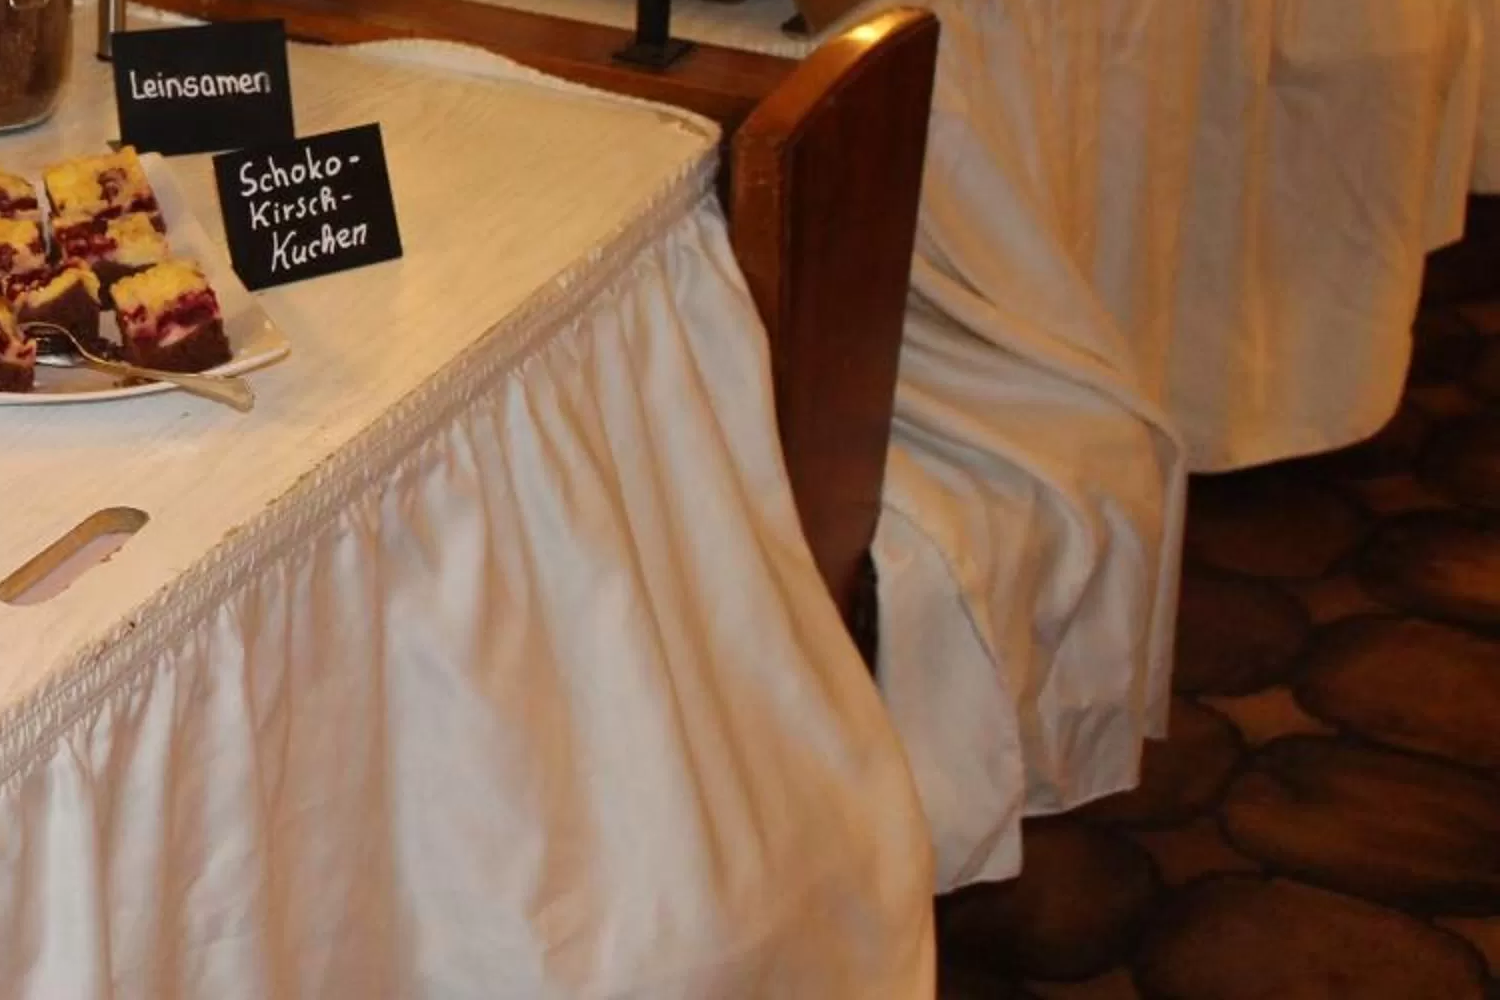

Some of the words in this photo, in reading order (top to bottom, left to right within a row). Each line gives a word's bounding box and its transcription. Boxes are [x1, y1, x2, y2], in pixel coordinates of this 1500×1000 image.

[129, 70, 271, 100] Leinsamen
[239, 147, 360, 197] Schoko-
[249, 185, 352, 230] Kirsch-
[271, 223, 367, 273] Kuchen
